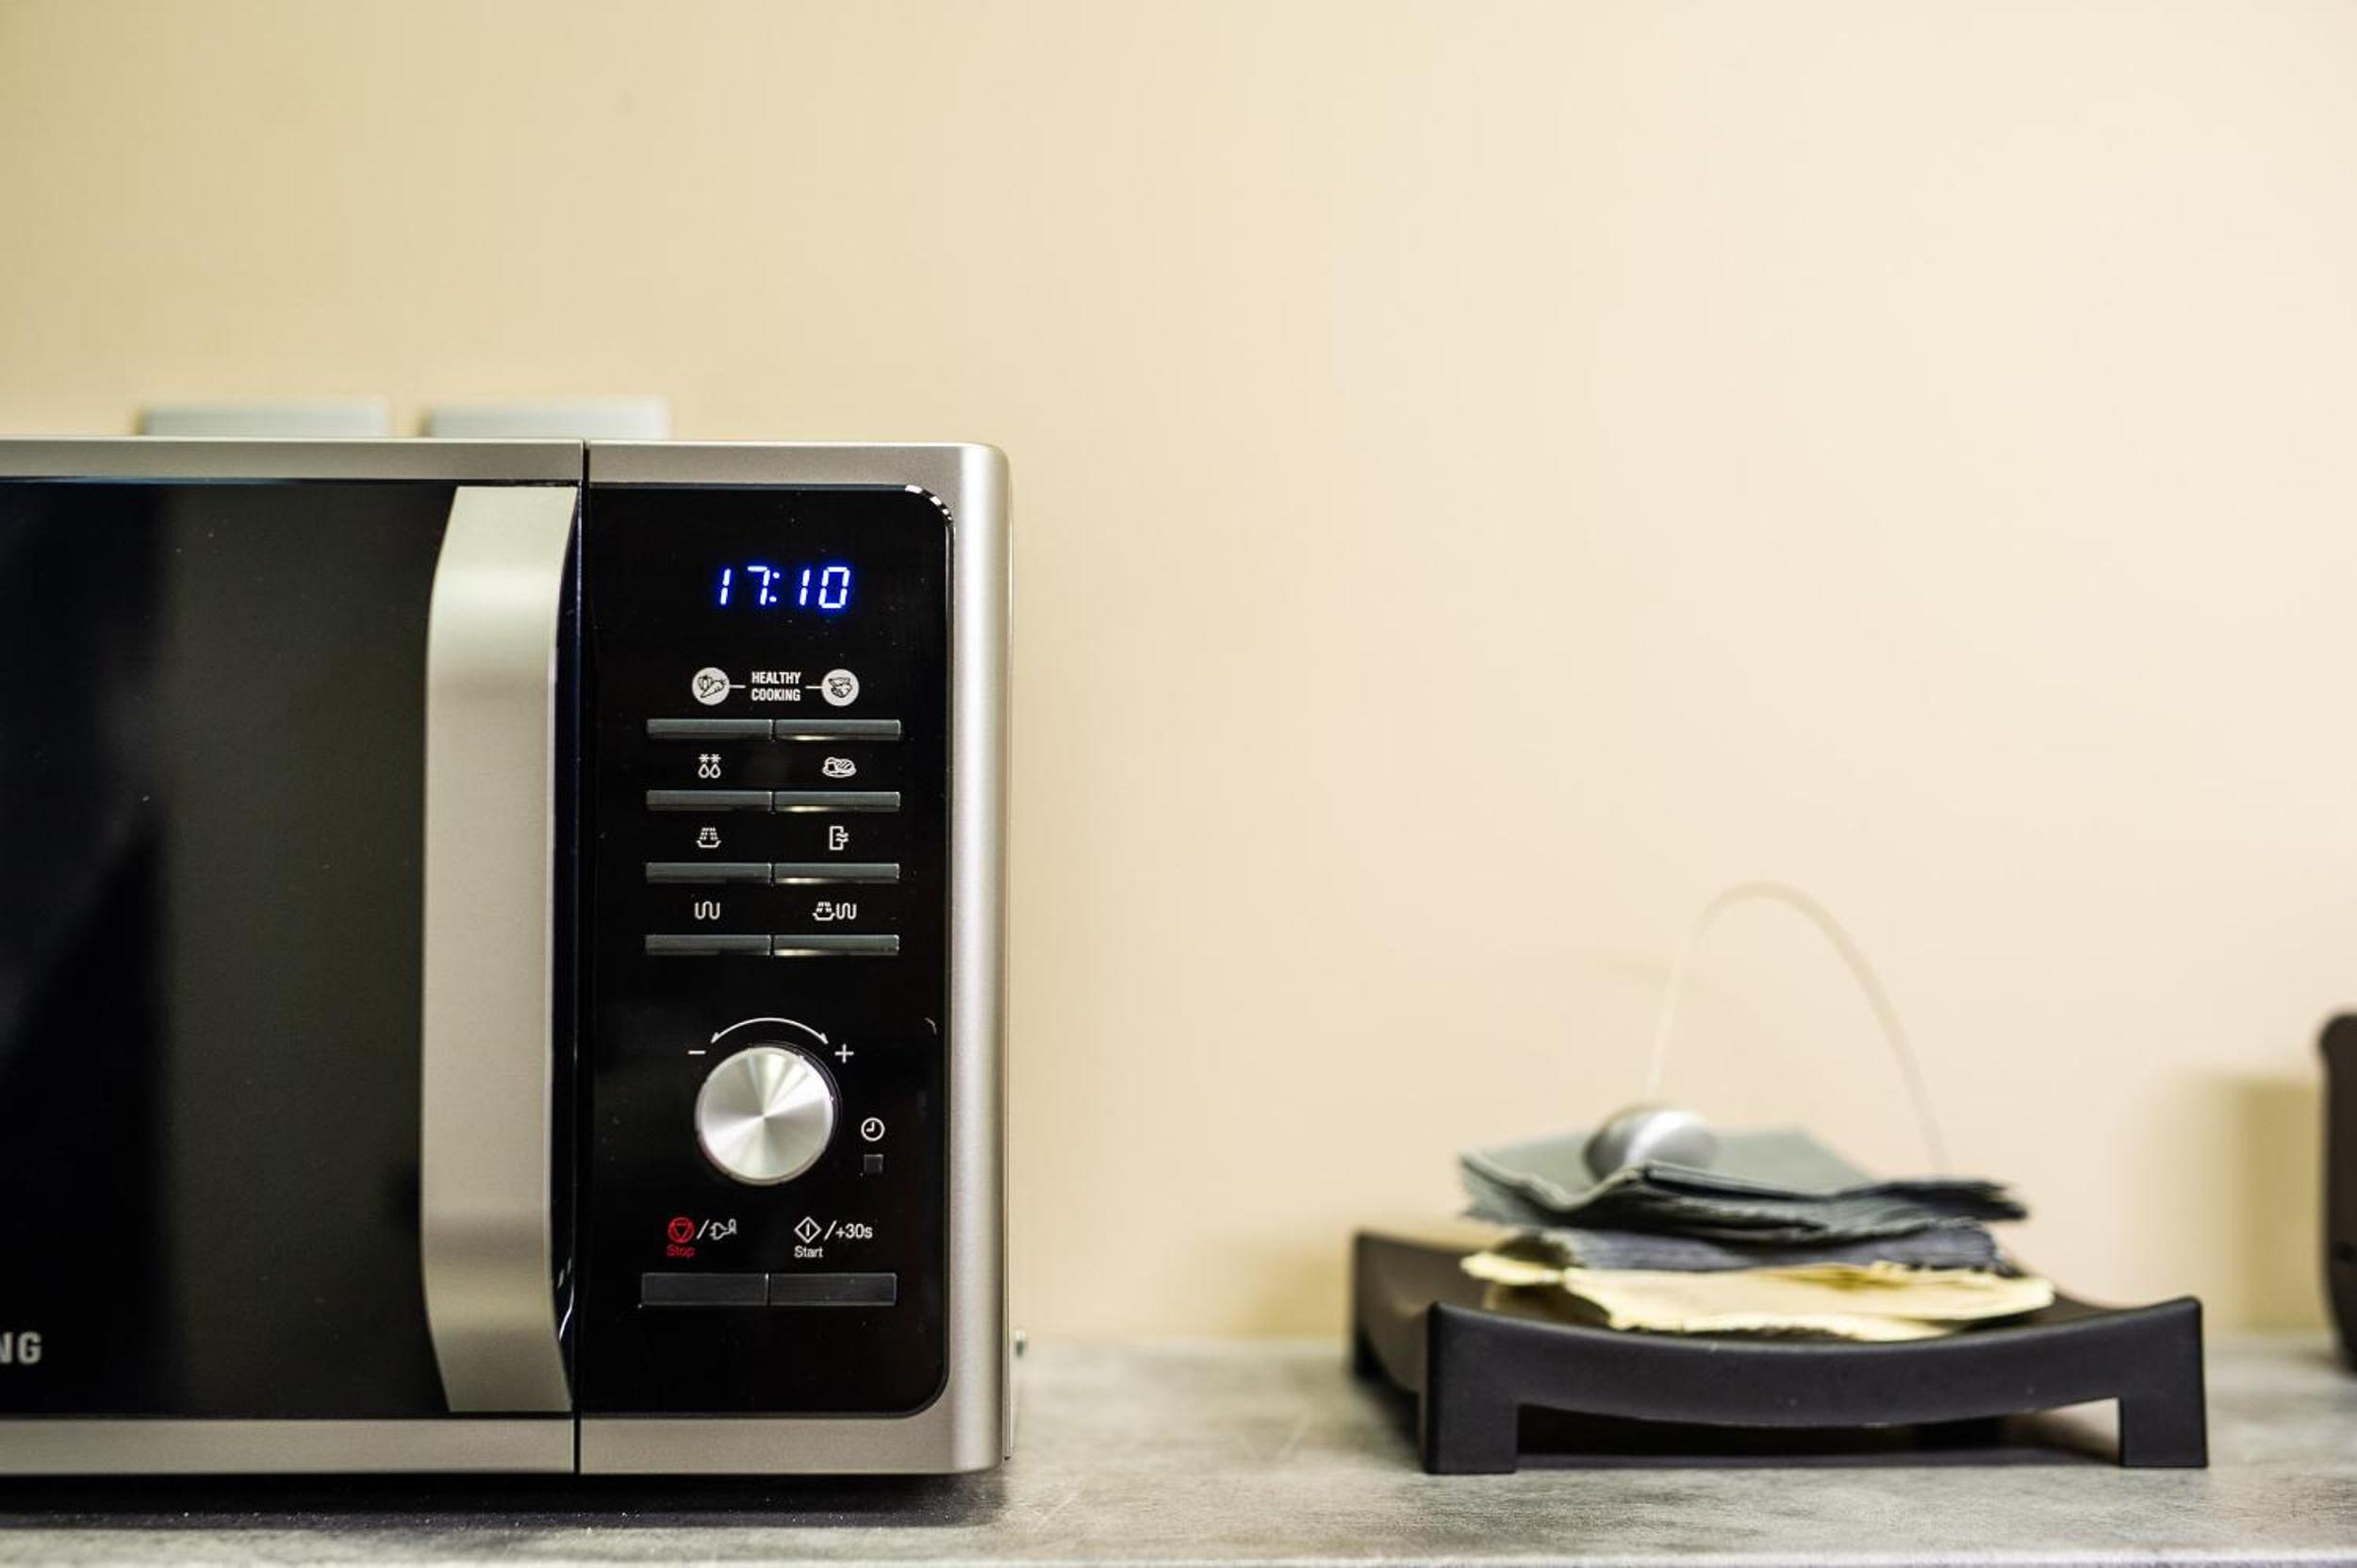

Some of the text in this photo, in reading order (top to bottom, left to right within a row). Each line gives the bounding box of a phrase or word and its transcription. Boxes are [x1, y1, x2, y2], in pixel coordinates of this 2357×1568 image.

[719, 566, 850, 608] 17:10
[751, 671, 801, 684] HEALTHY
[751, 688, 800, 701] COOKING
[666, 1245, 696, 1258] Stop
[794, 1246, 823, 1258] Start
